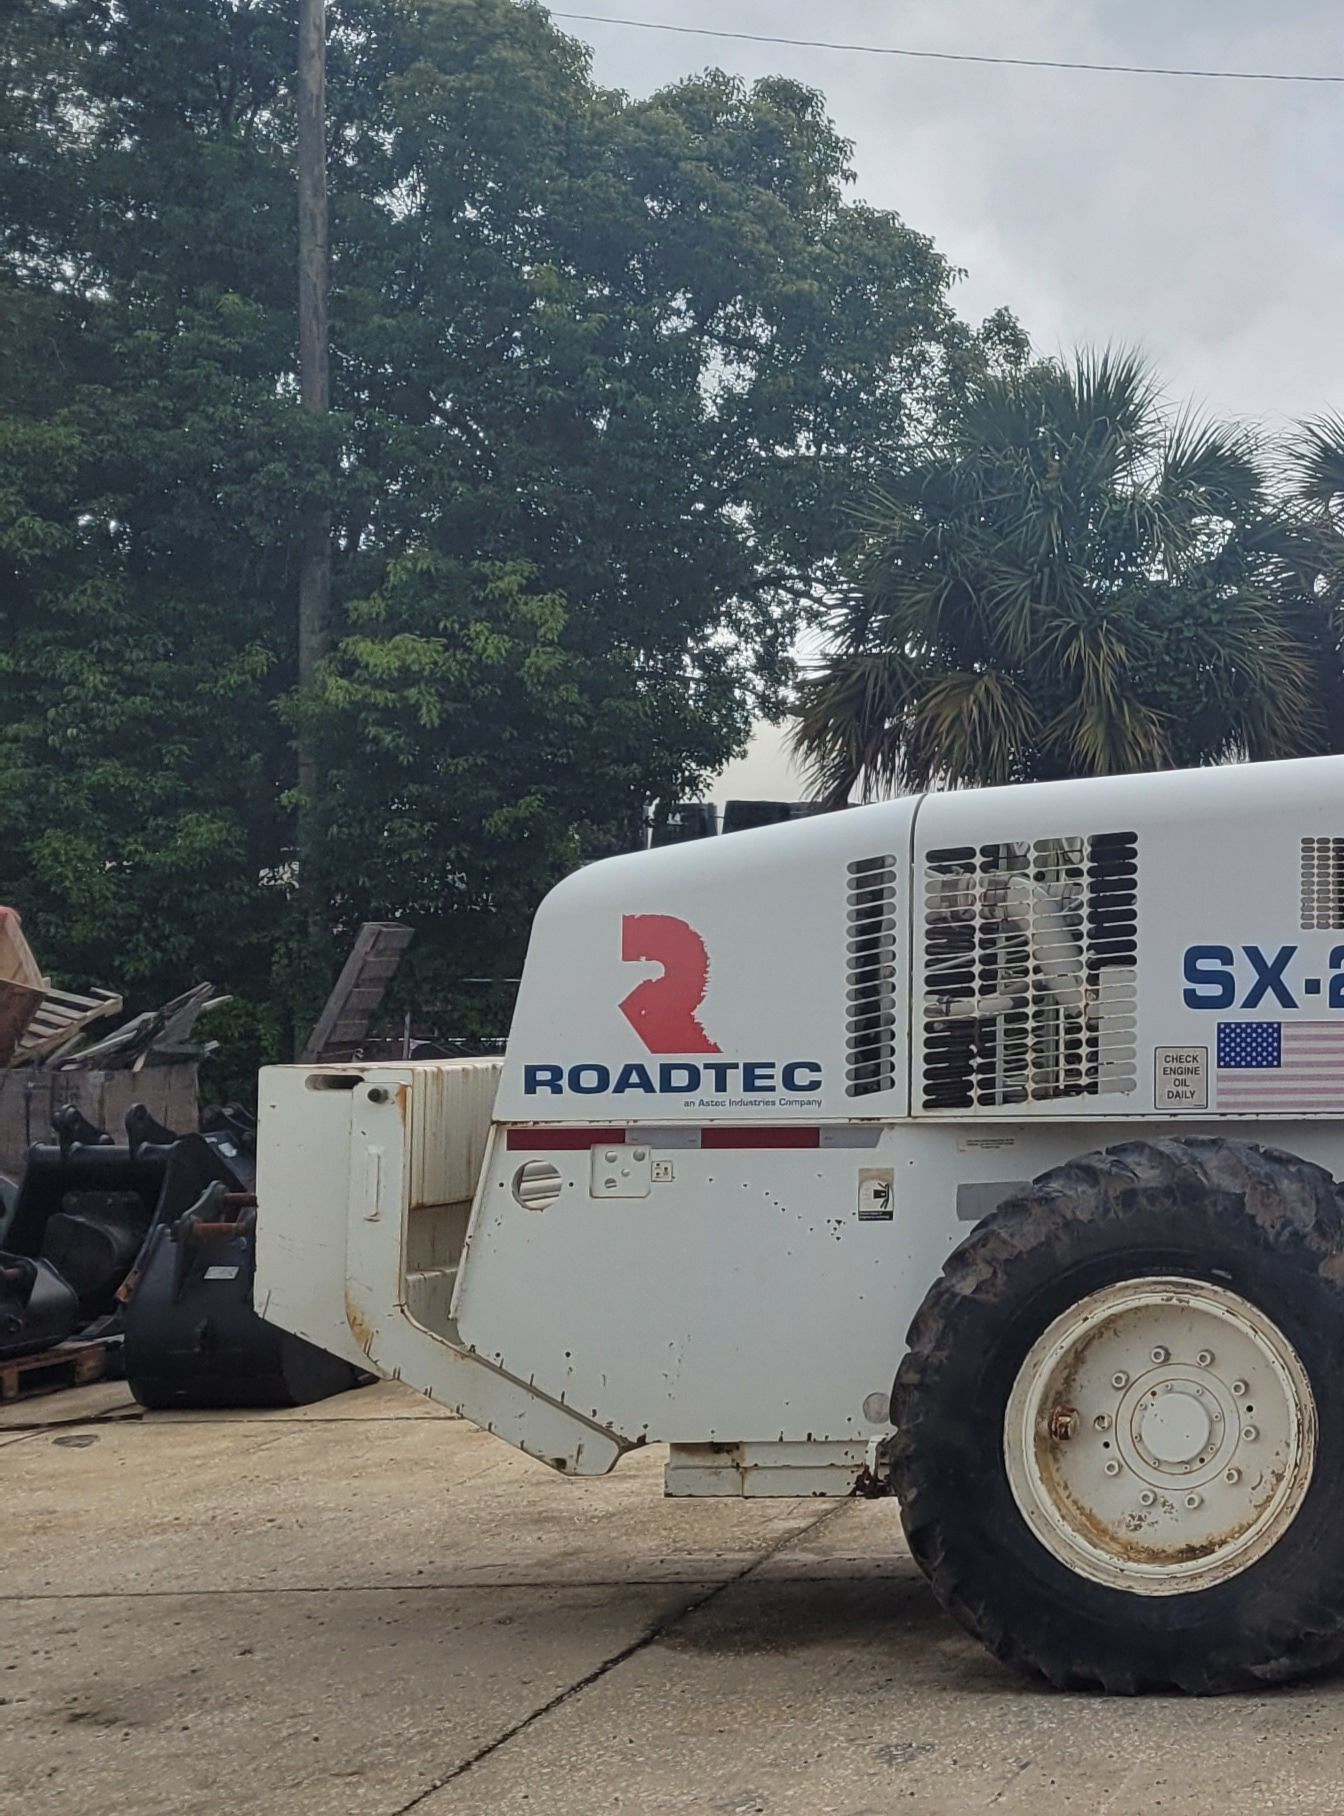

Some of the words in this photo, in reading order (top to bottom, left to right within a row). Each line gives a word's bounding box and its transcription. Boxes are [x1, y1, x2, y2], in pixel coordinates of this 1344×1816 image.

[1164, 1054, 1199, 1064] CHECK
[1162, 1066, 1201, 1076] ENGINE
[524, 1061, 822, 1095] ROADTEC
[1173, 1078, 1190, 1088] OIL
[1167, 1090, 1196, 1099] DAILY
[698, 1098, 726, 1107] Astec
[729, 1098, 776, 1107] Industries
[779, 1098, 822, 1108] Company
